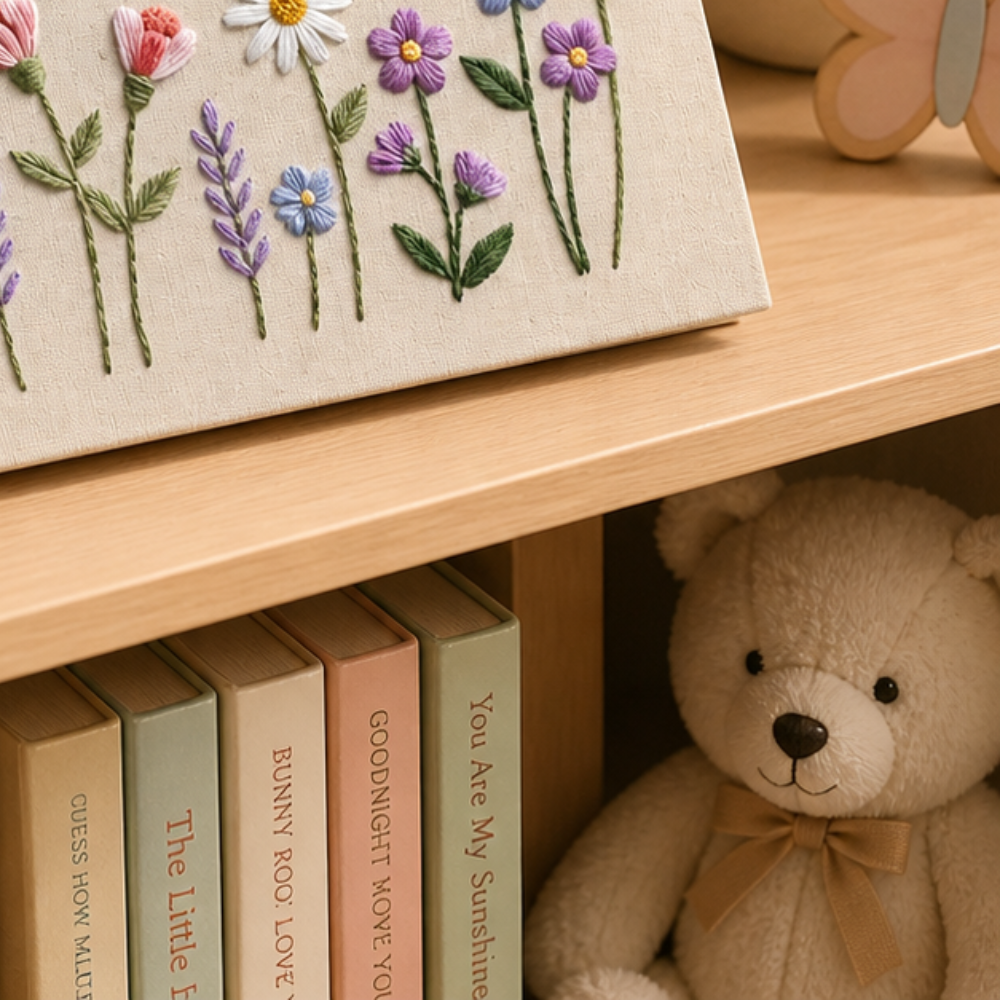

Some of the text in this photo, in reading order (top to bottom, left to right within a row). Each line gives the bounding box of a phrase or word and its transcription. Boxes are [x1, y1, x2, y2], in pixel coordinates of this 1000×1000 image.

[272, 745, 293, 838] BUNNY
[369, 708, 391, 867] GOODNIGHT
[165, 808, 194, 878] The
[465, 692, 497, 1000] You Are My Sunshine
[71, 872, 91, 927] HOW
[168, 886, 197, 972] Little
[371, 876, 392, 951] MOVE
[274, 918, 295, 989] LOVE
